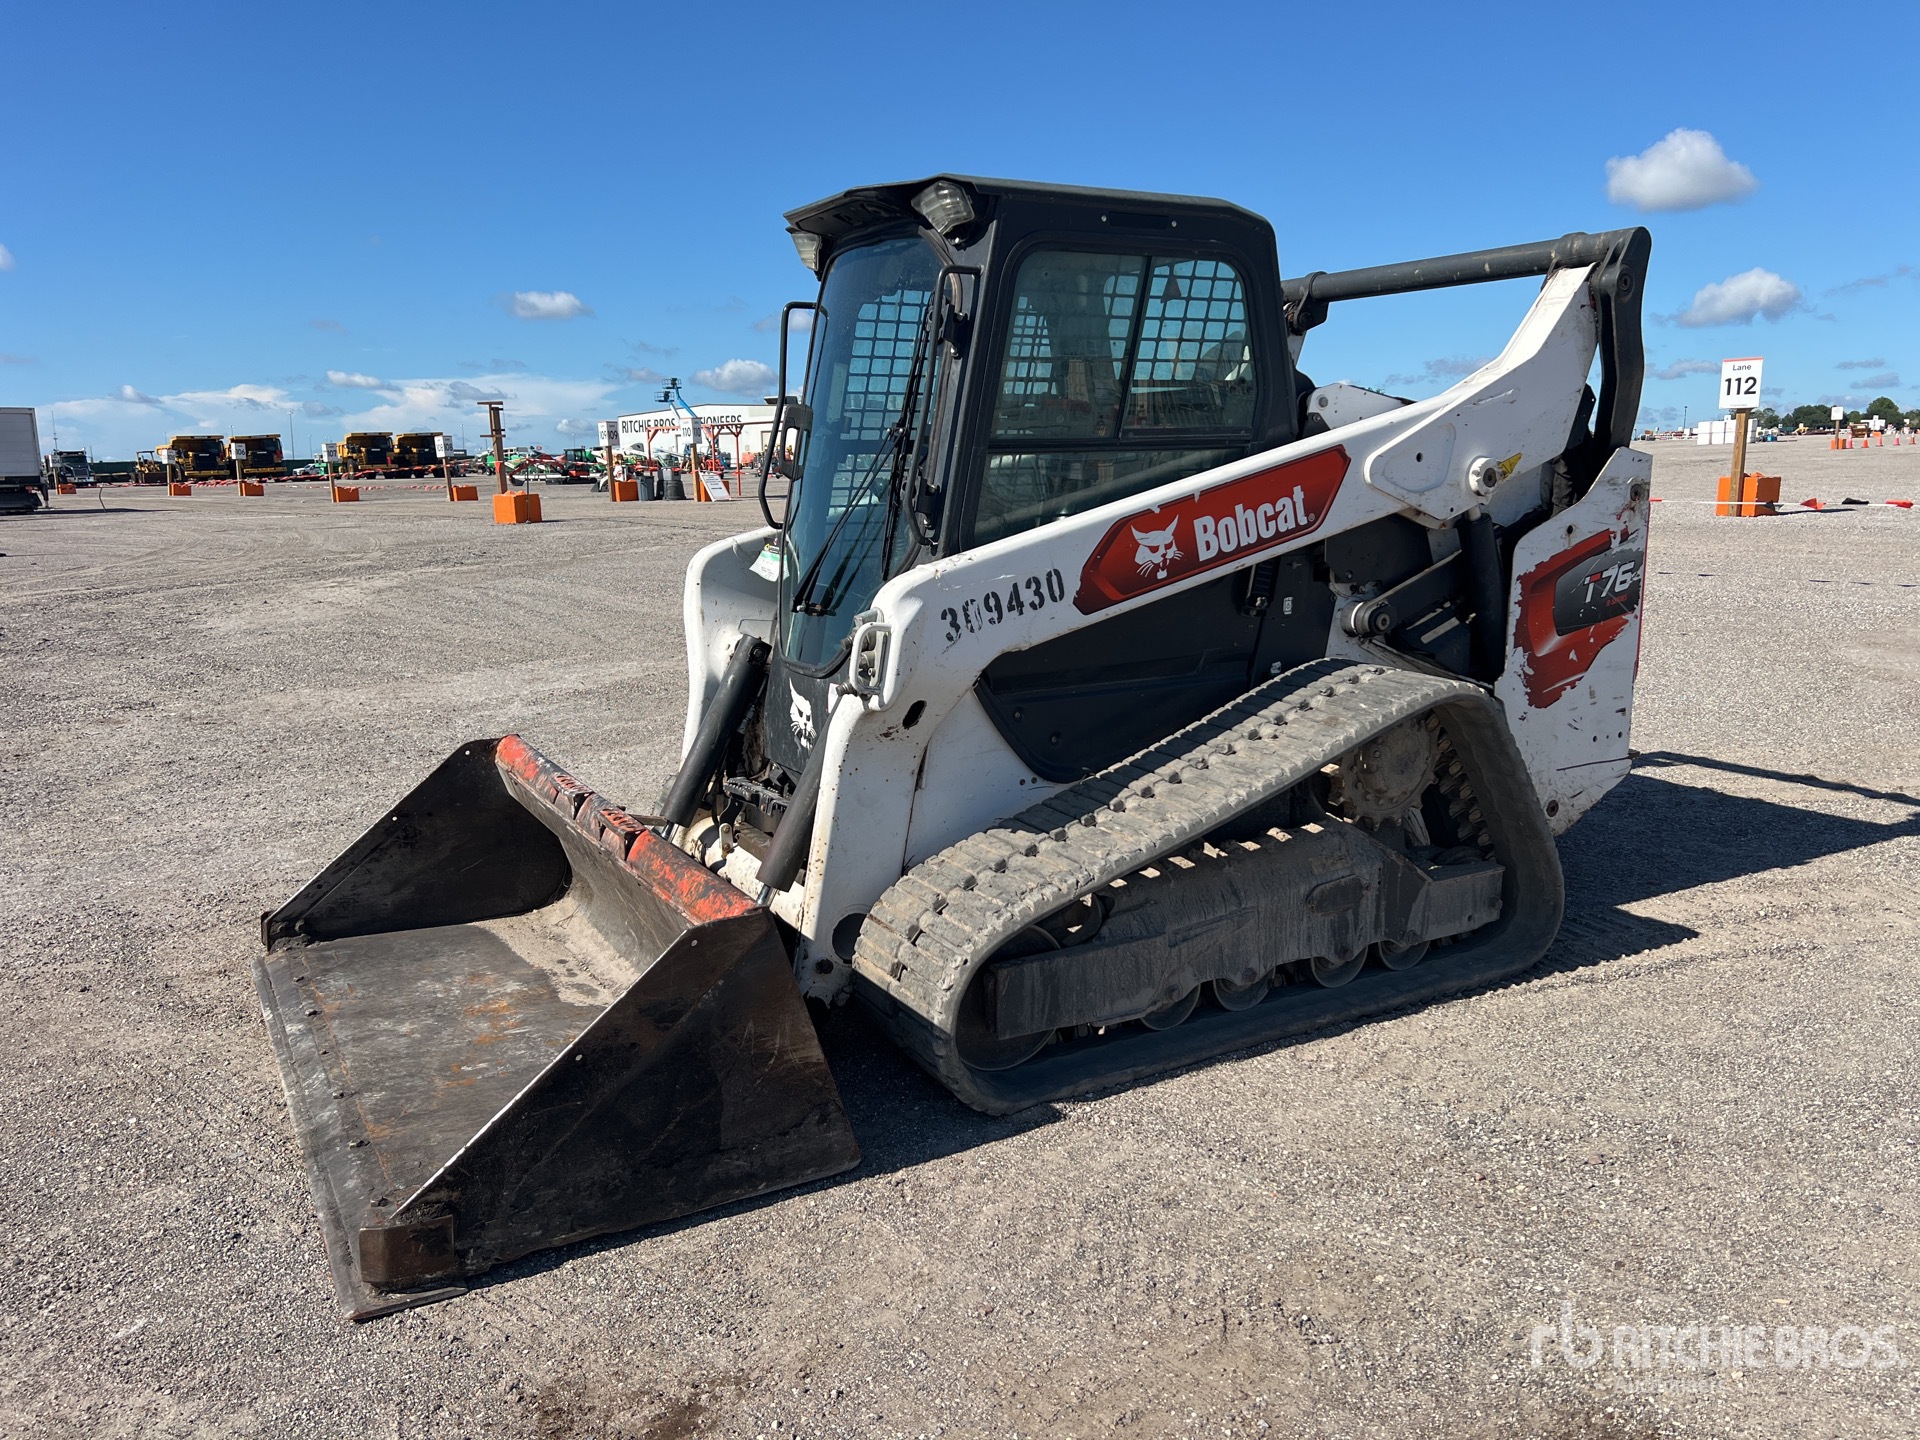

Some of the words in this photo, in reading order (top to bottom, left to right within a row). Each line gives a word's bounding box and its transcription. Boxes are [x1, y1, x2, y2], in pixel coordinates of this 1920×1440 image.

[1725, 376, 1757, 395] 112
[621, 419, 652, 433] RITCHIE
[682, 427, 691, 437] 110
[608, 430, 618, 440] 109
[1193, 485, 1308, 562] Bobcat
[940, 568, 1065, 643] 309430
